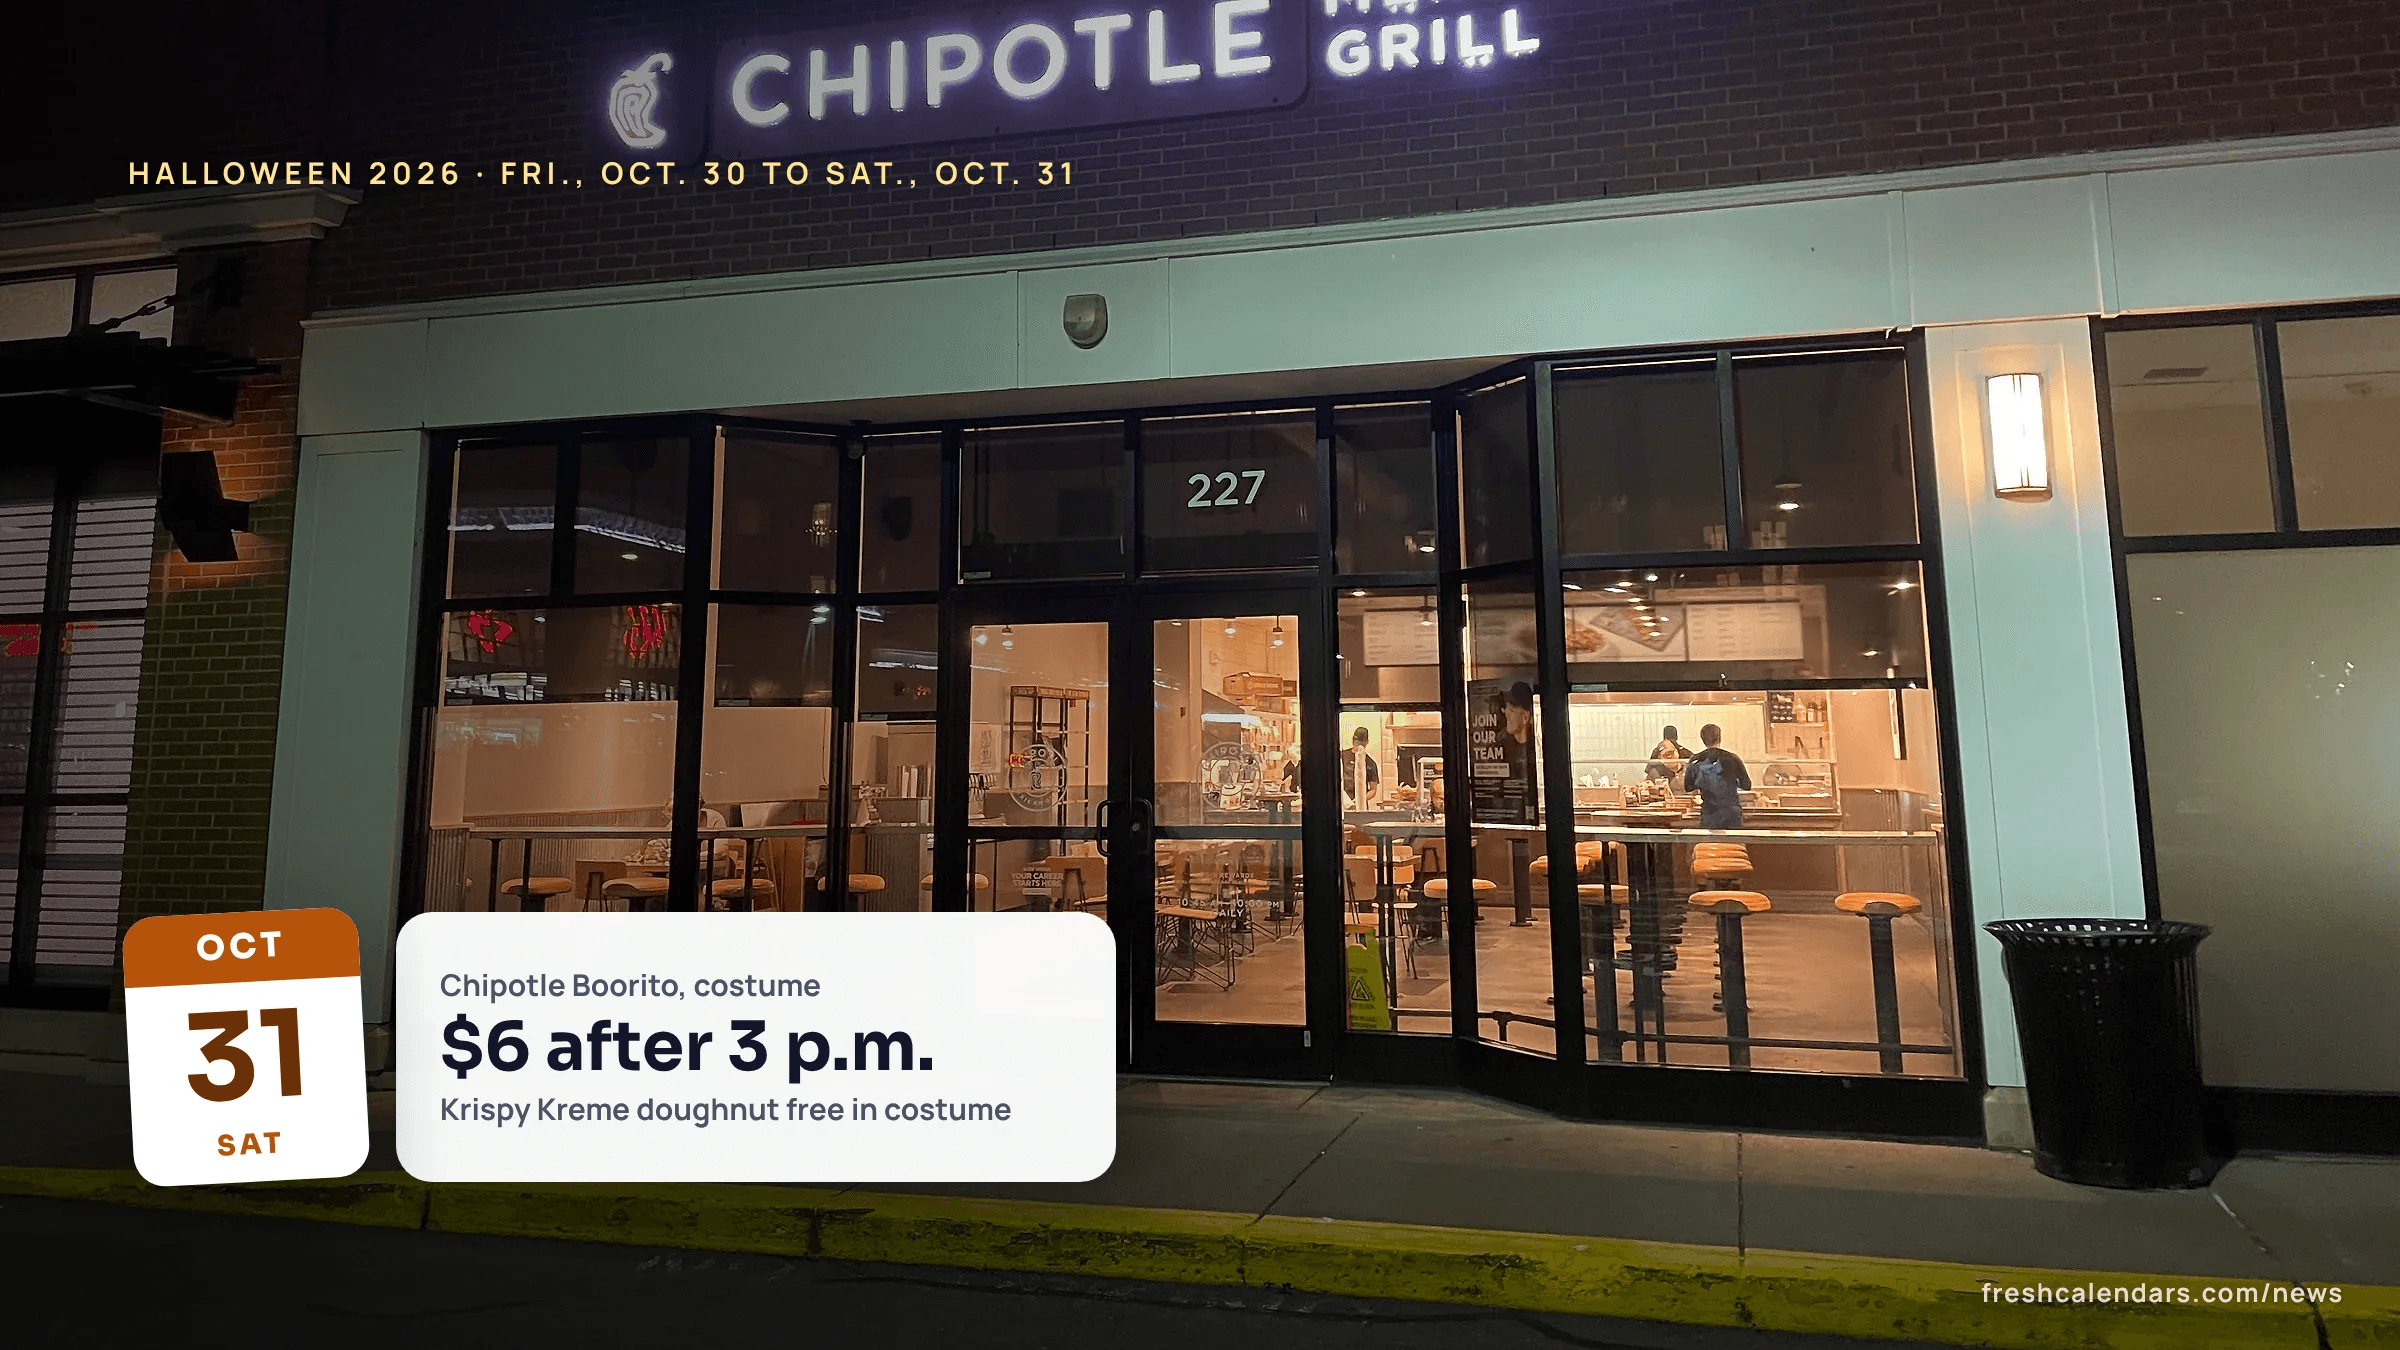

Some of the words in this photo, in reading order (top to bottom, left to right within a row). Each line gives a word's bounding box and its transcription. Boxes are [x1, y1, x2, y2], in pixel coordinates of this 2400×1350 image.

[1326, 9, 1540, 77] GRILL
[731, 0, 1271, 126] CHIPOTLE
[1187, 469, 1266, 508] 227
[1472, 714, 1497, 727] JOIN
[1473, 730, 1496, 743] OUR
[1473, 747, 1504, 760] TEAM
[1011, 872, 1032, 880] YOUR
[1033, 872, 1064, 880] CAREER
[1213, 908, 1244, 918] AILY
